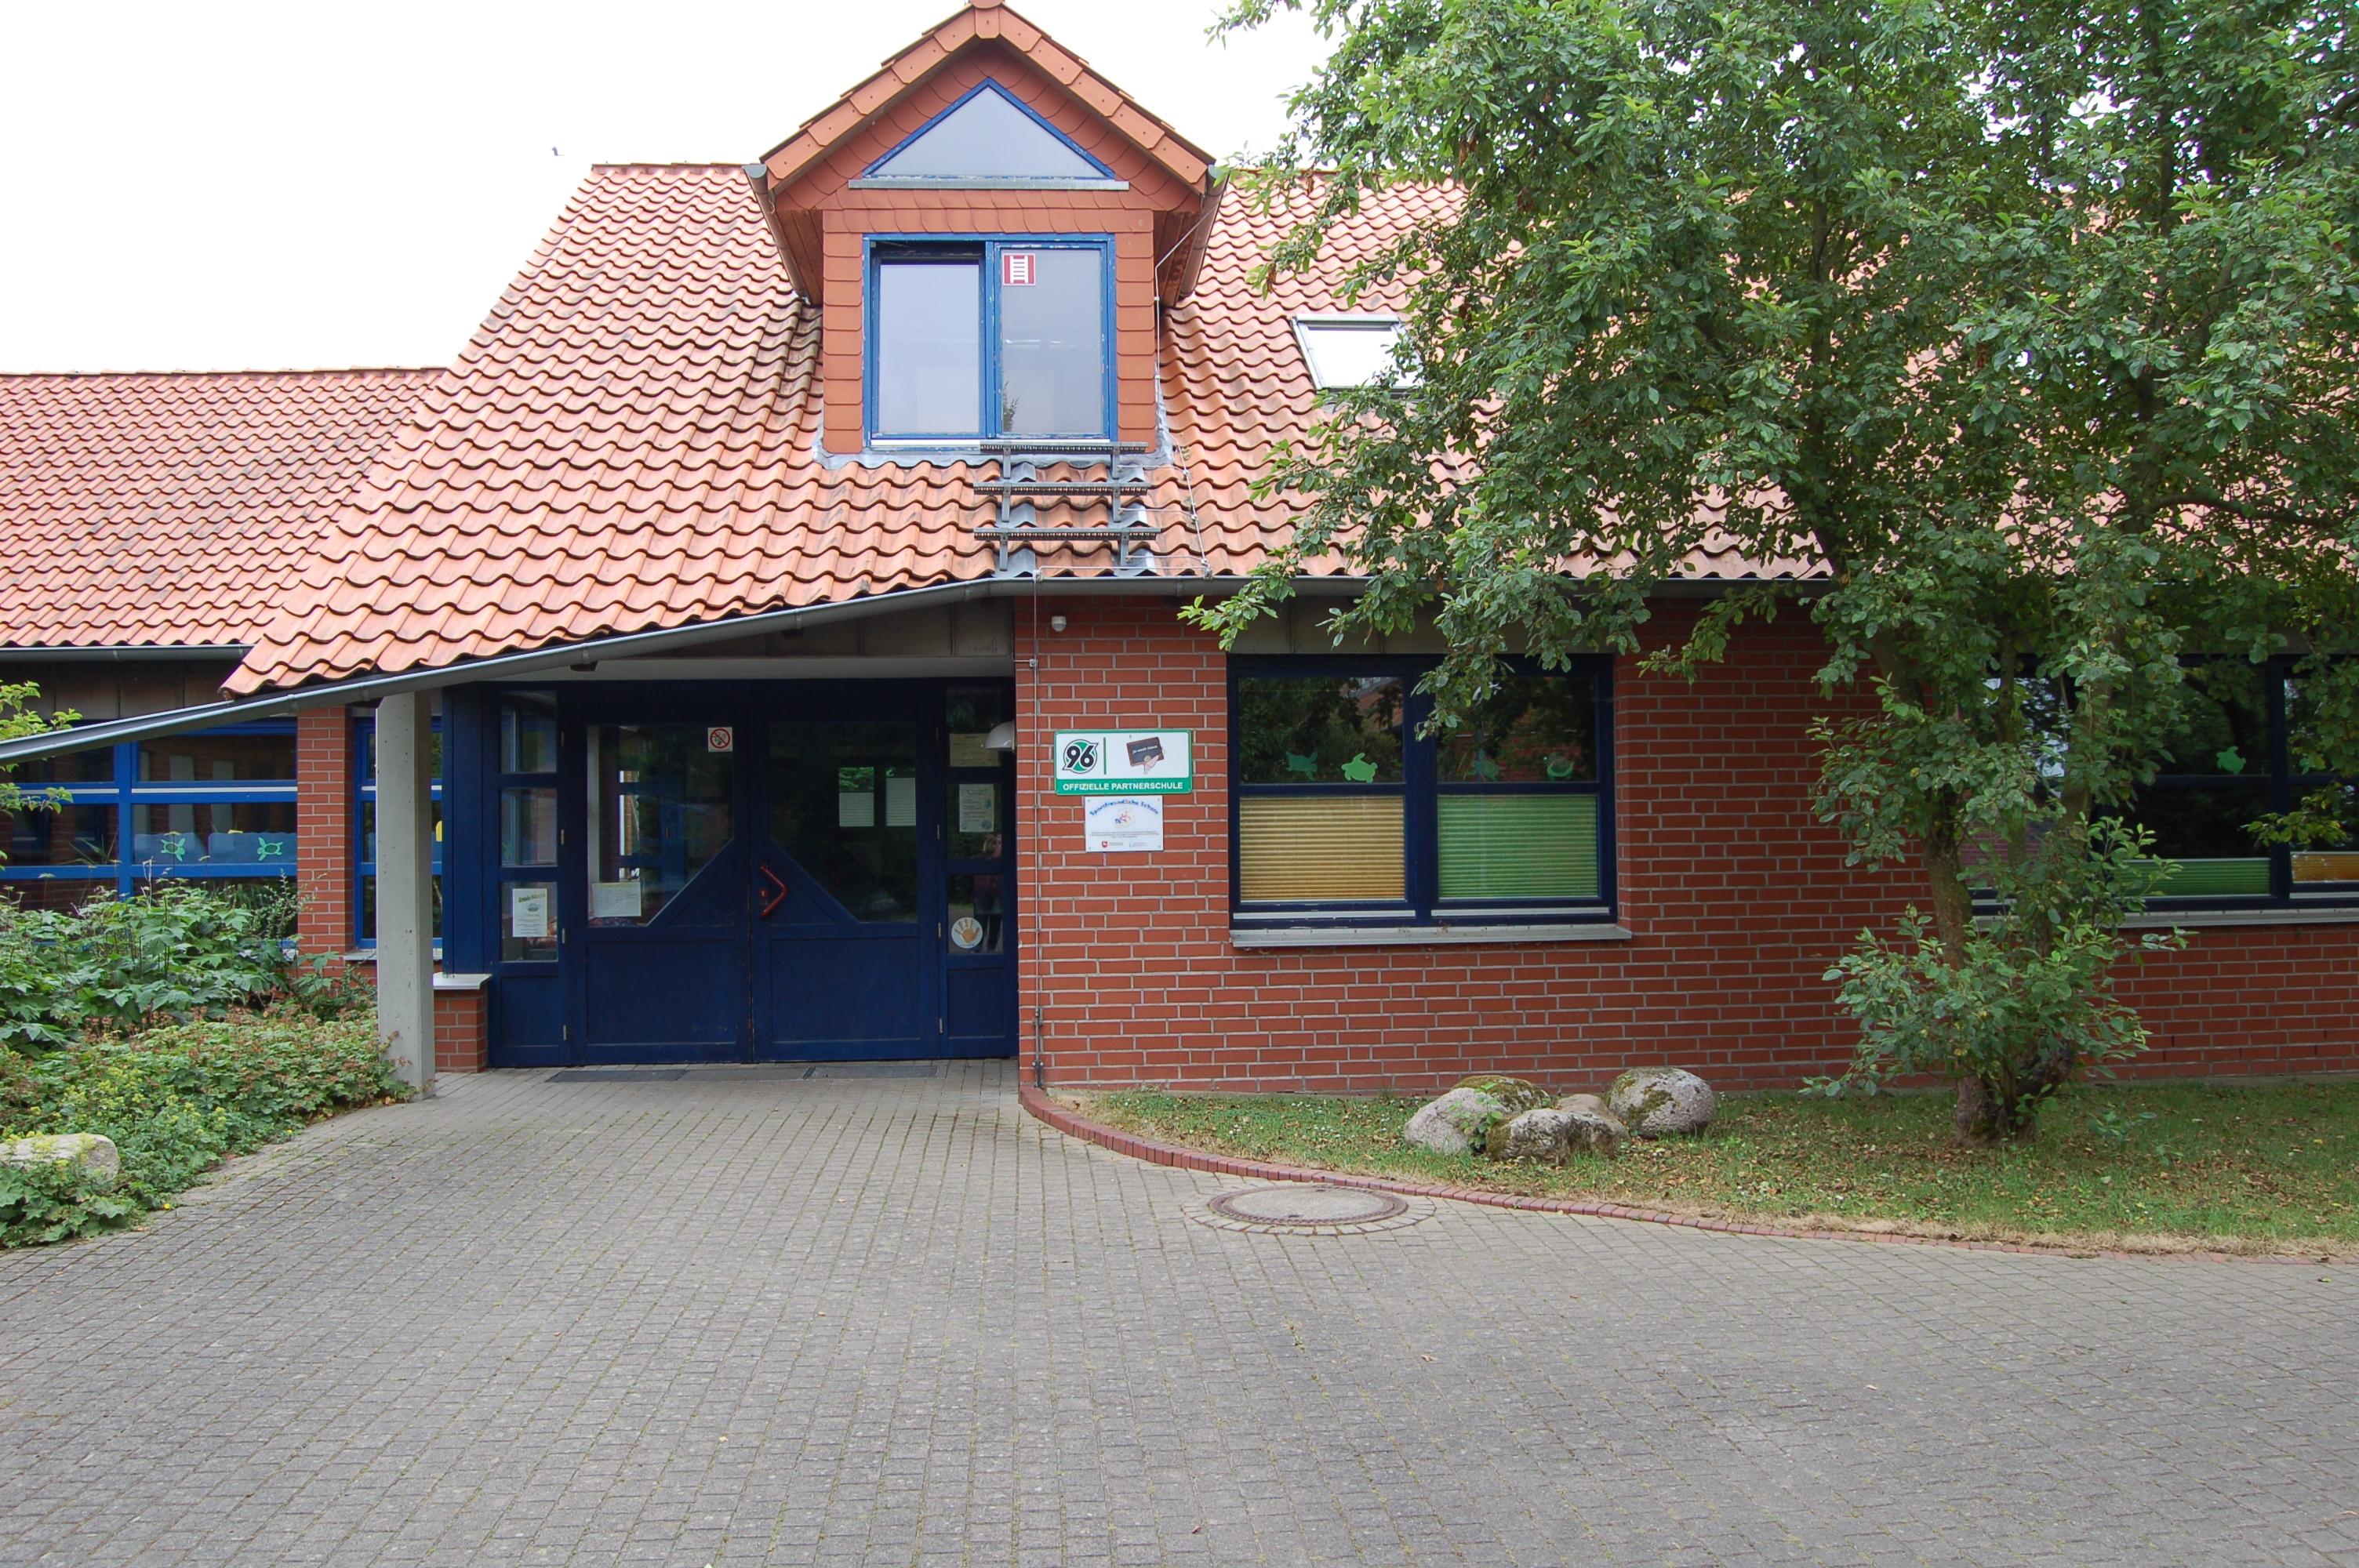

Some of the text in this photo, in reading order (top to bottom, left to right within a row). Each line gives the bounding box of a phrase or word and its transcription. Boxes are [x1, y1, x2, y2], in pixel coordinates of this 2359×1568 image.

[1067, 745, 1095, 768] 96
[1063, 782, 1183, 791] OFFIZIELLE PARTNERSCHULE
[1140, 801, 1158, 815] Schule
